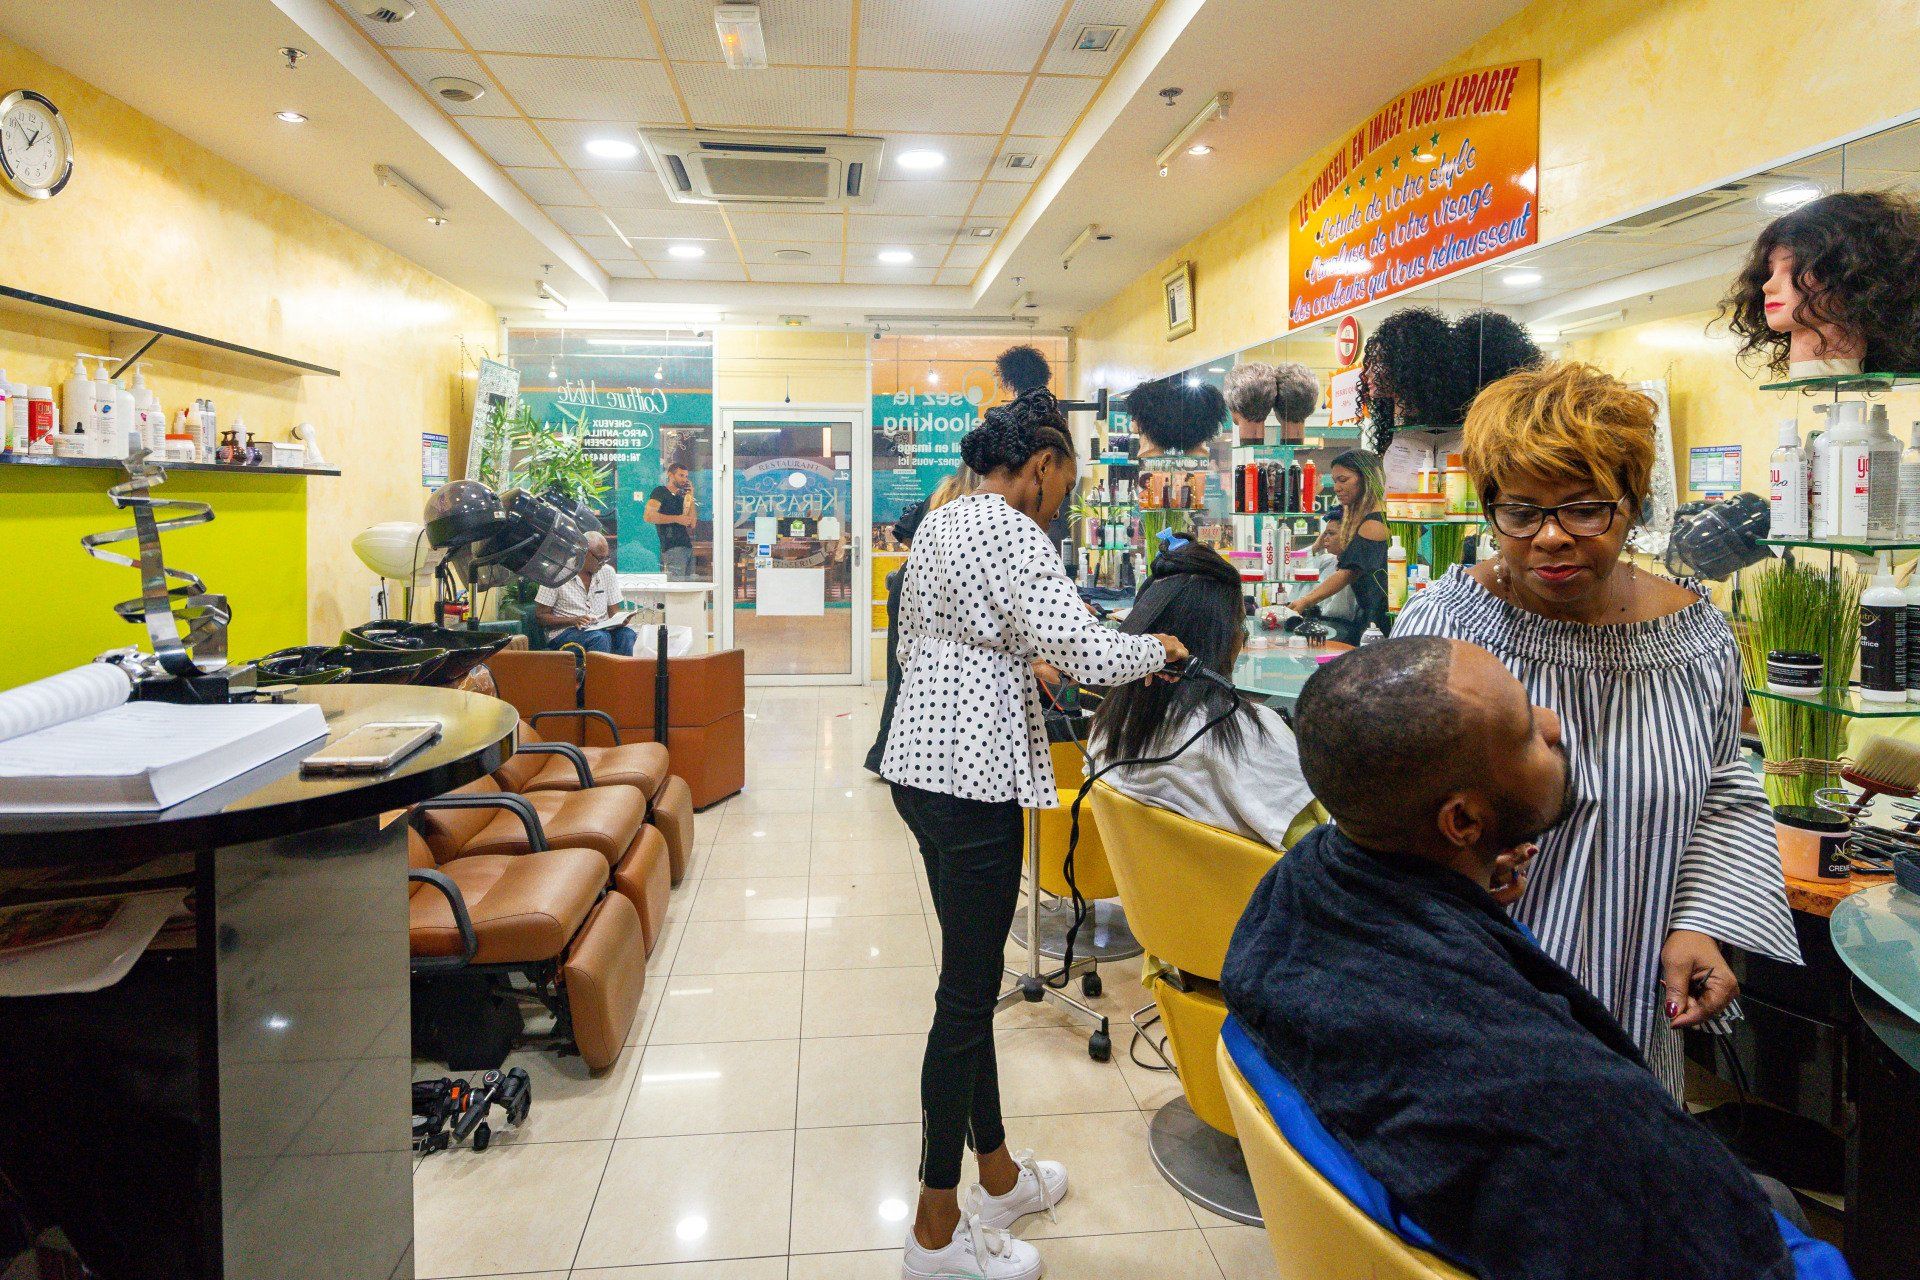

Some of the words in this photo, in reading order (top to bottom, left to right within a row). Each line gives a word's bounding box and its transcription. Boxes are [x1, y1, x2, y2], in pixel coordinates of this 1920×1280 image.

[1299, 194, 1309, 228] LE
[1311, 148, 1348, 212] CONSEIL
[1352, 129, 1365, 170] EN
[1368, 99, 1405, 154] IMAGE
[1407, 82, 1446, 132] VOUS
[1444, 66, 1520, 119] APPORTE
[1366, 192, 1382, 222] de
[1385, 174, 1425, 212] votre
[1428, 138, 1477, 190] style
[1369, 226, 1386, 257] de
[1390, 211, 1430, 249] votre
[1433, 182, 1494, 229] visage
[1312, 278, 1366, 316] couleurs
[1368, 259, 1391, 301] qui
[1392, 256, 1426, 285] vous
[758, 460, 820, 471] RESTAURANT
